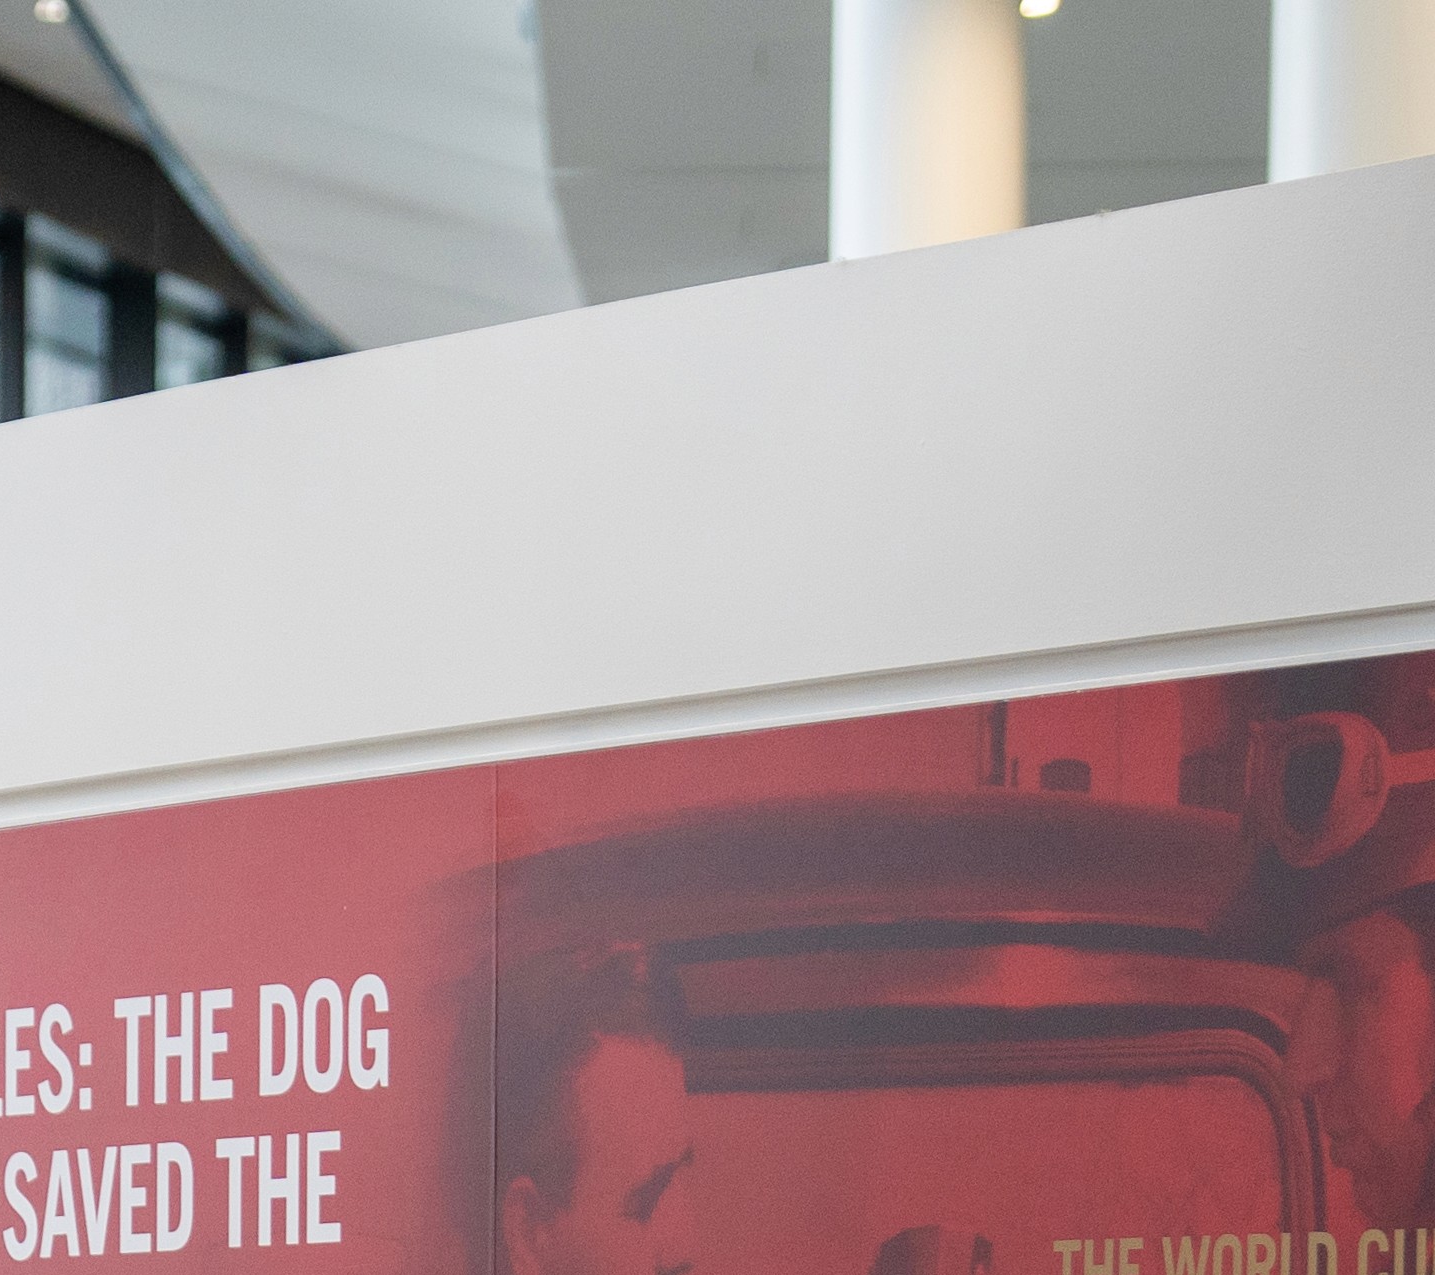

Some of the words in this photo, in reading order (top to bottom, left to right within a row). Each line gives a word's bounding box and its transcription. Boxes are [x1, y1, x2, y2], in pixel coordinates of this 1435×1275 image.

[115, 989, 233, 1106] THE
[259, 973, 390, 1096] DOG
[3, 1141, 193, 1261] SAVED
[216, 1131, 341, 1248] THE
